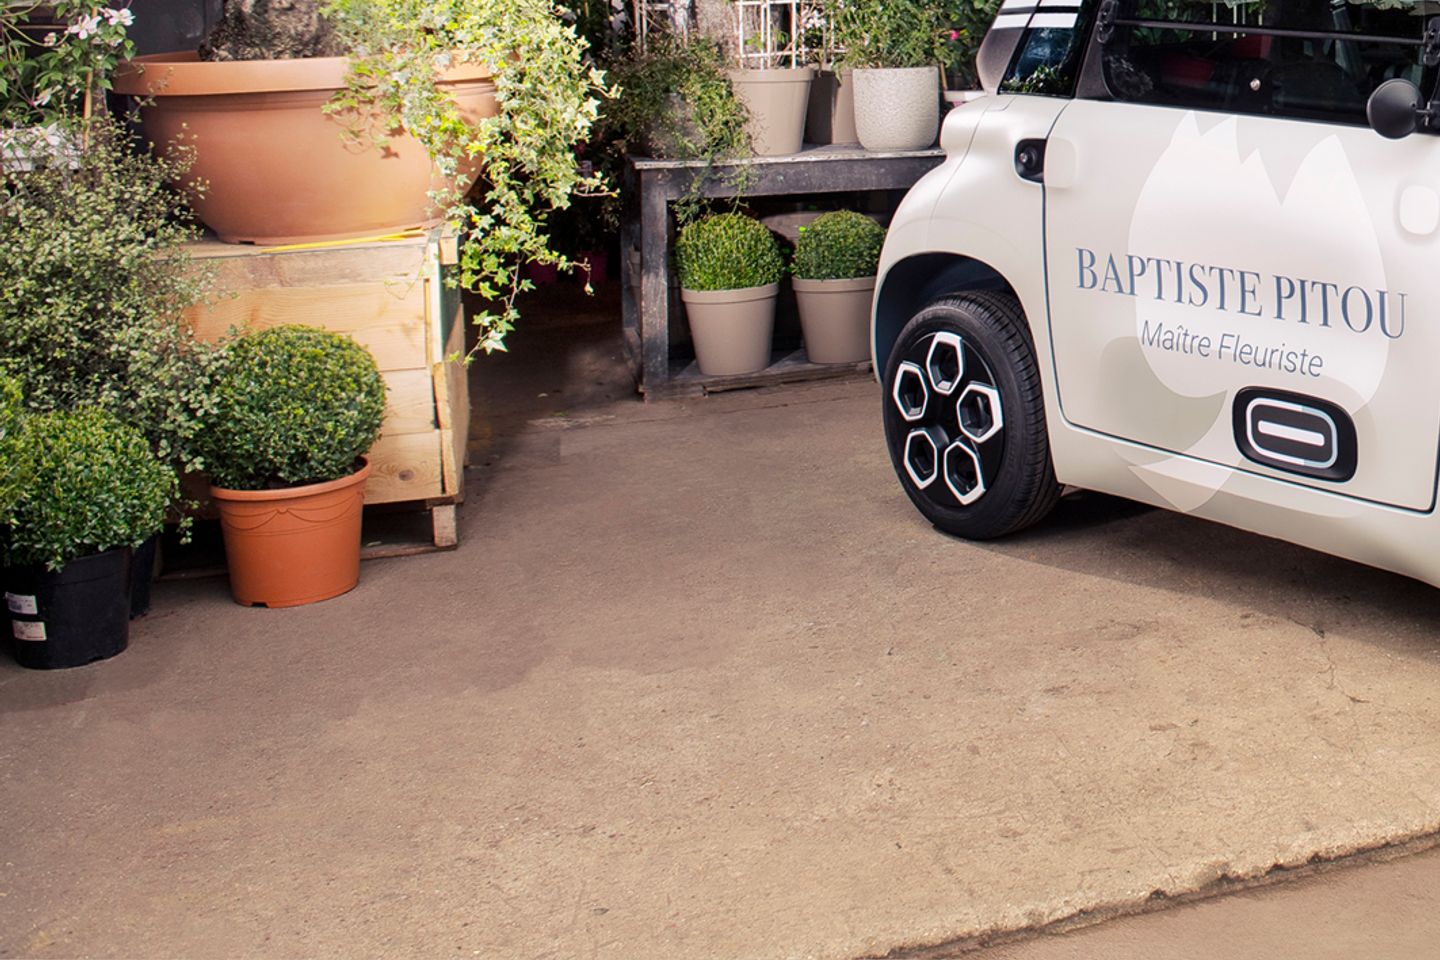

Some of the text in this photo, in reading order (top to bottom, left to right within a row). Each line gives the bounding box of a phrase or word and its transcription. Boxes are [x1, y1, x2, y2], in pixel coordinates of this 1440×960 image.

[1075, 247, 1409, 340] BAPTISTE PITOU
[1140, 319, 1324, 378] Maître Fleuriste
